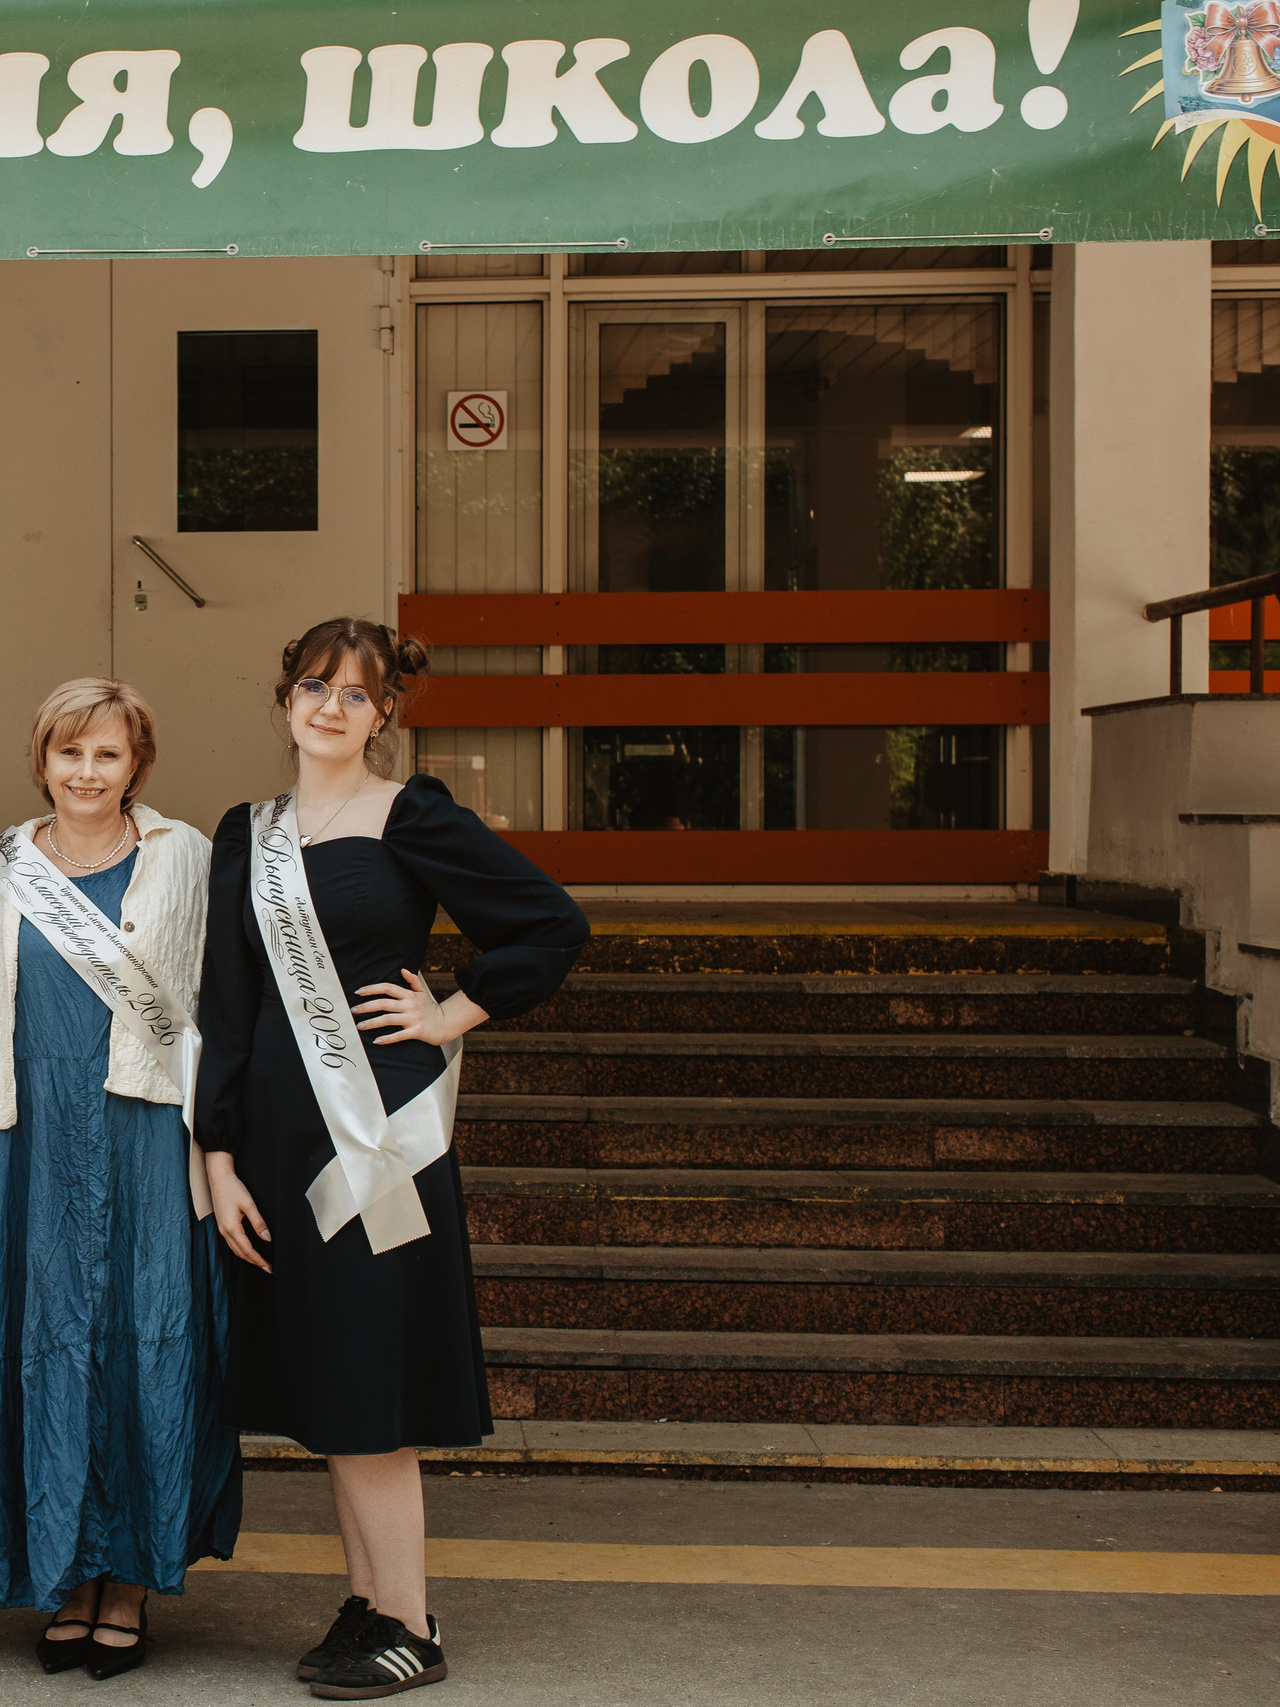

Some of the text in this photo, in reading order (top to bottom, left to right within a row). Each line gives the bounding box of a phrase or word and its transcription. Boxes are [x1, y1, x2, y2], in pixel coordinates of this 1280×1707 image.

[292, 0, 1081, 153] школа!
[12, 861, 90, 931] Классный
[85, 911, 108, 935] Елена
[105, 931, 159, 989] Александровна
[255, 826, 357, 1069] Выпускница 2026
[32, 911, 184, 1047] руководитель 2026
